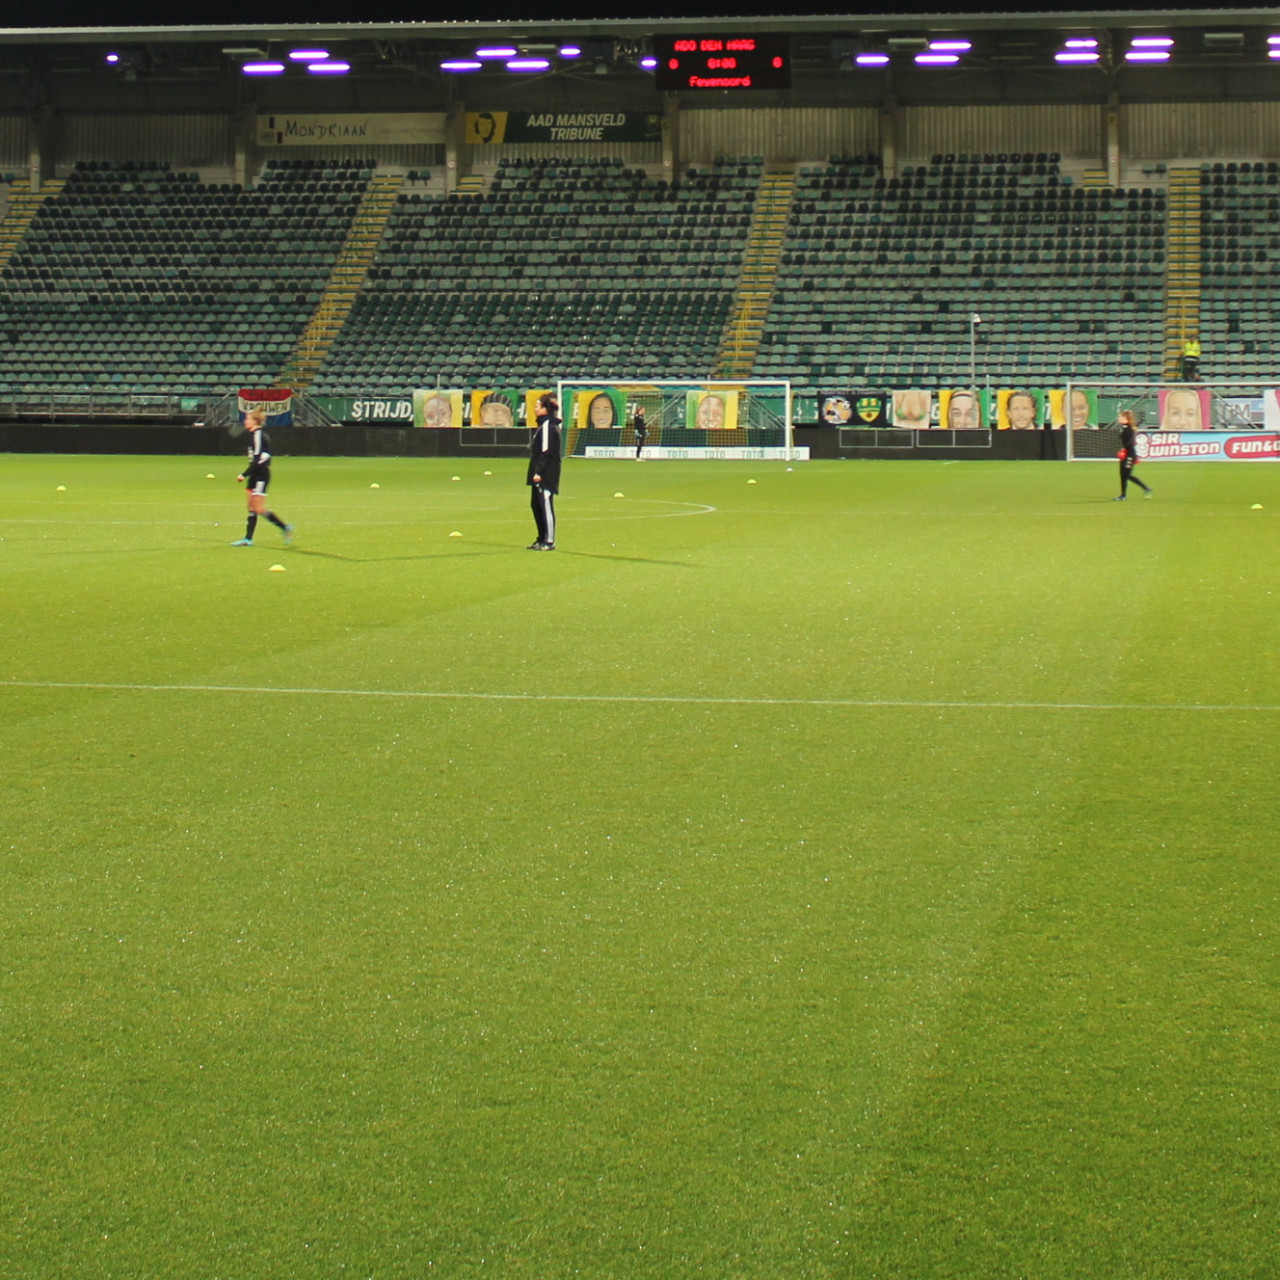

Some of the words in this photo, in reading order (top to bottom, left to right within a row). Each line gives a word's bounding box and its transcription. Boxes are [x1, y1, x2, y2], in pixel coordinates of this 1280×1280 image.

[674, 40, 697, 51] ADO
[700, 40, 723, 51] DEN
[726, 39, 755, 51] HAAG
[689, 75, 751, 87] Feyenoord
[527, 115, 554, 127] AAD
[556, 114, 626, 127] MANSVELD
[550, 128, 604, 140] TRIBUNE
[1150, 433, 1180, 444] SIR
[1150, 442, 1219, 456] WINSTON
